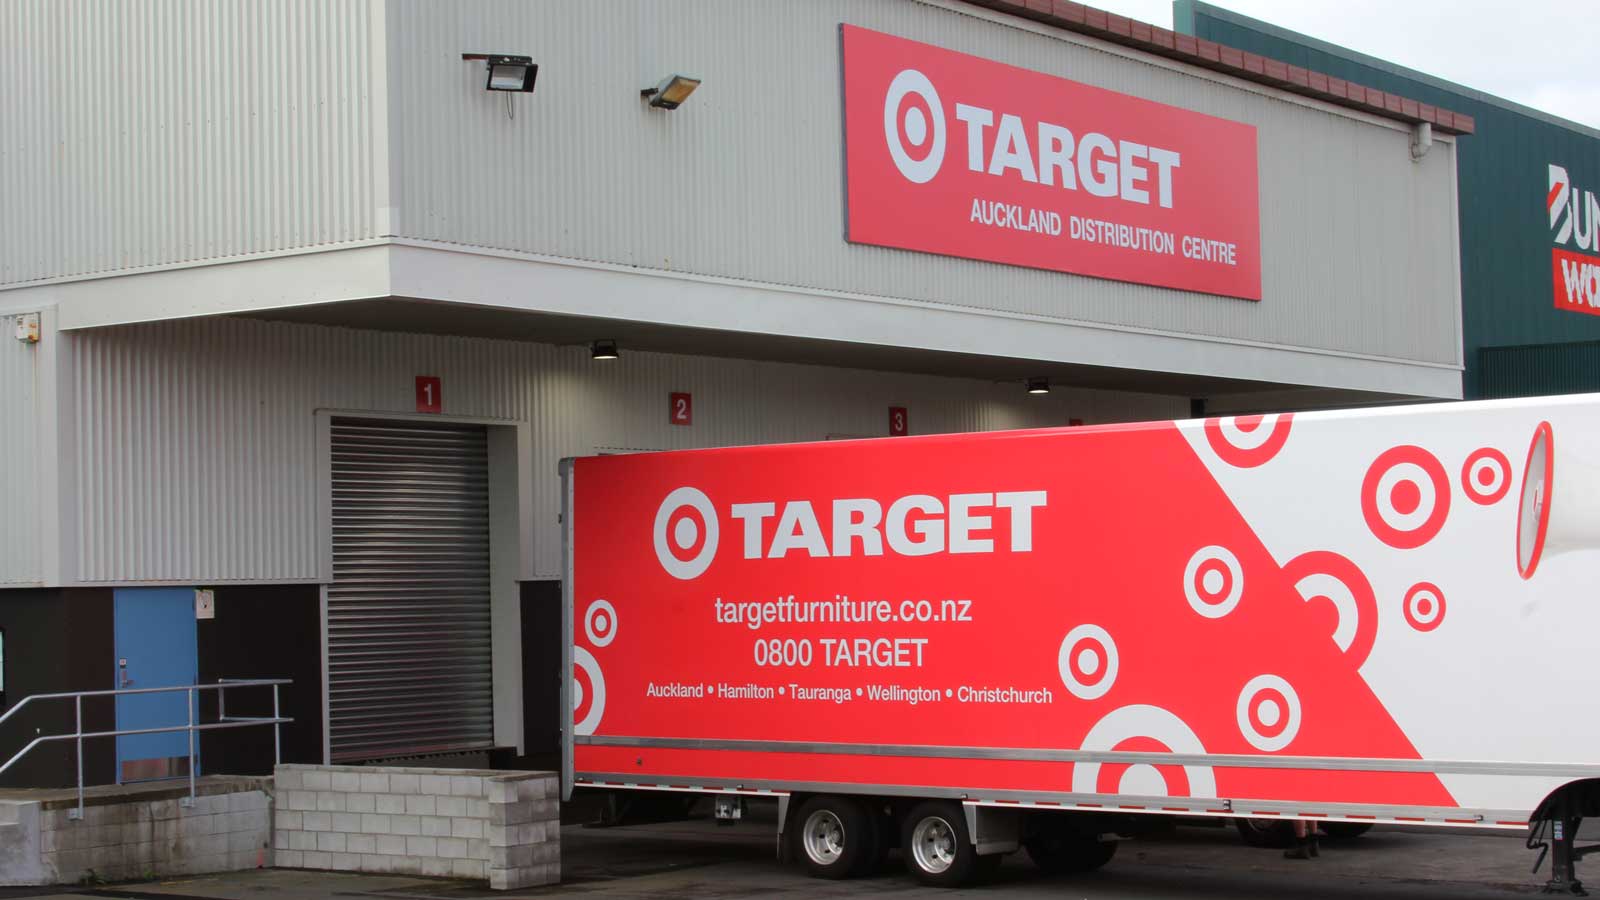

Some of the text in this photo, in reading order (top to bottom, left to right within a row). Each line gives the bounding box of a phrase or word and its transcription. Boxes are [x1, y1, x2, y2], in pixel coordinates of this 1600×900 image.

[955, 103, 1181, 209] TARGET
[970, 198, 1237, 266] AUCKLAND DISTRIBUTION CENTRE
[423, 383, 433, 406] 1
[676, 399, 687, 419] 2
[895, 412, 904, 431] 3
[731, 490, 1047, 560] TARGET
[714, 595, 973, 630] targetfurniture.co.nz
[753, 637, 929, 667] 0800 TARGET
[646, 683, 1053, 705] Auckland Hamilton Tauranga Wellington Christchurch
